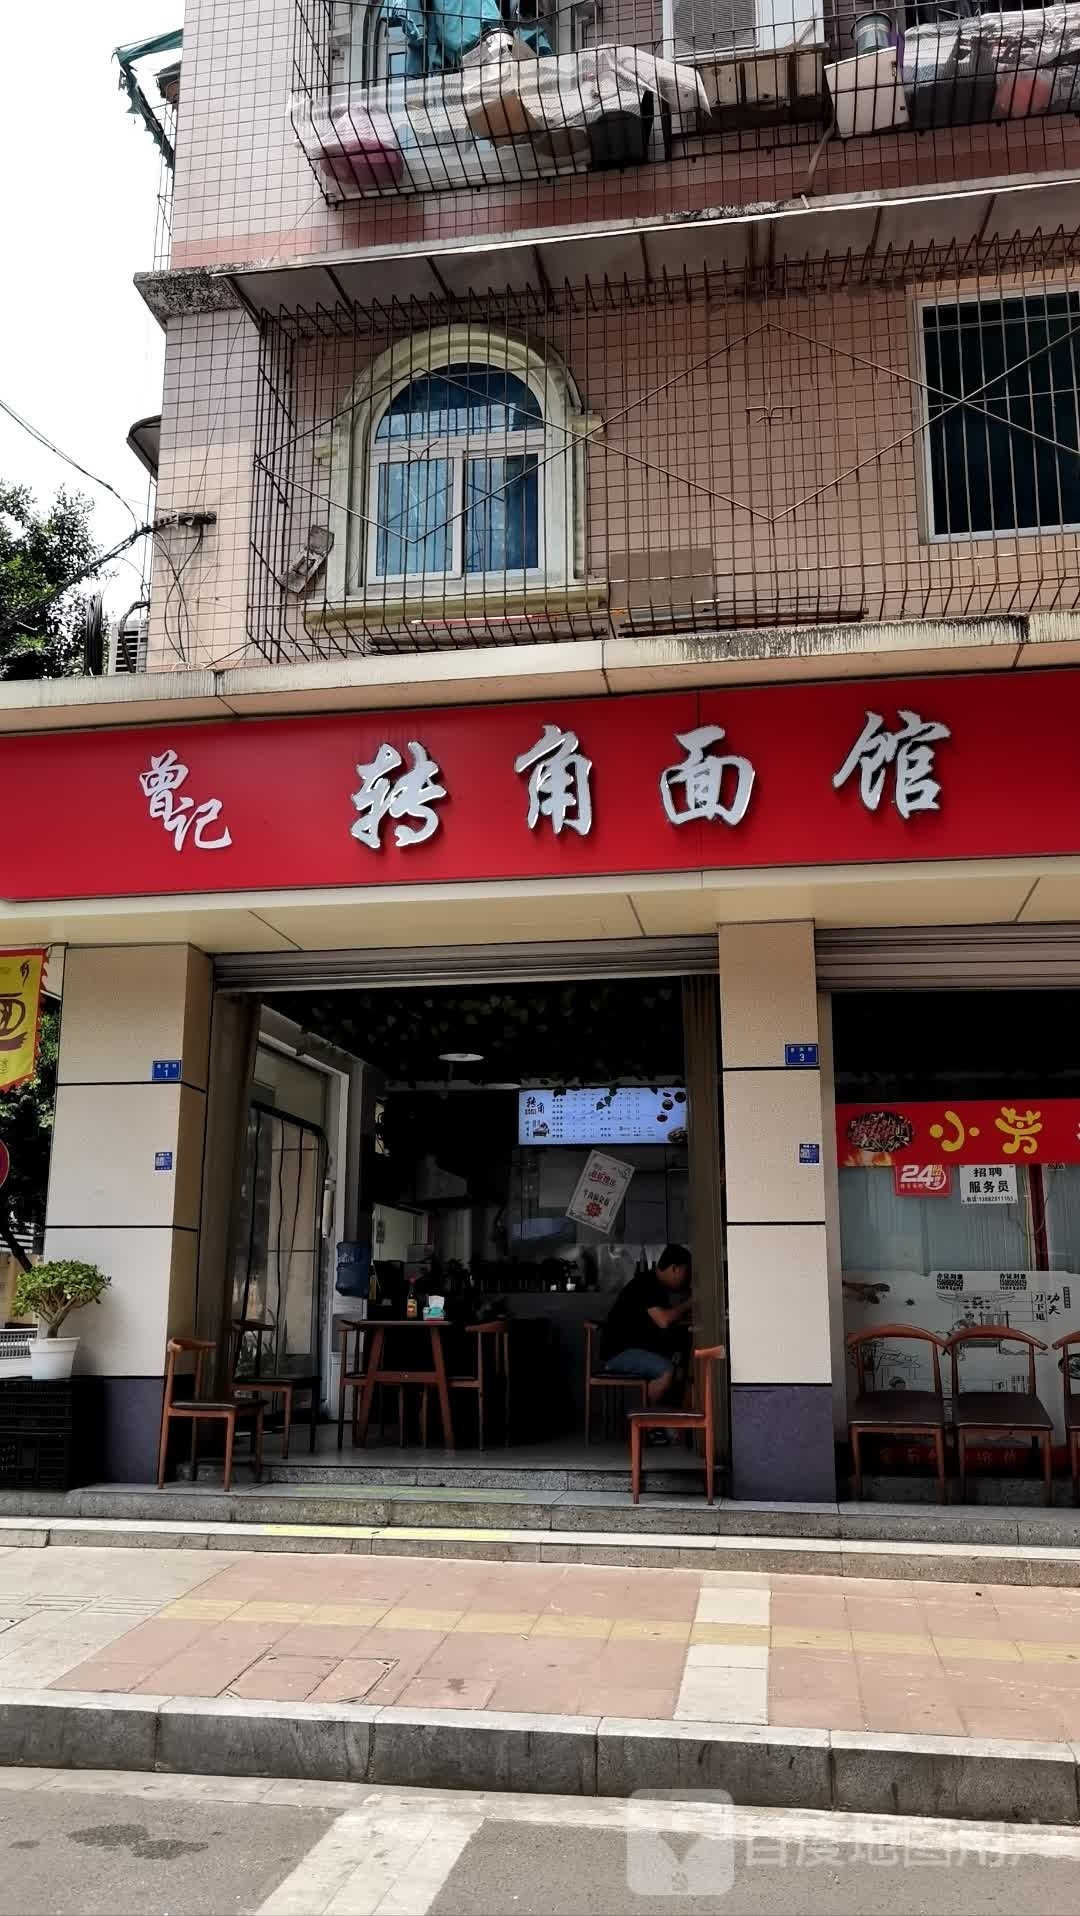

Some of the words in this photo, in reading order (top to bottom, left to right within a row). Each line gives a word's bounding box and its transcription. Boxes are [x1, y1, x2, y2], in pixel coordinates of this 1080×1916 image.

[350, 711, 952, 849] 转角面馆
[138, 750, 231, 852] 曾记
[799, 1053, 805, 1062] 3
[164, 1069, 168, 1078] 1
[973, 1167, 1003, 1178] 招聘
[969, 1181, 1009, 1193] 服务员
